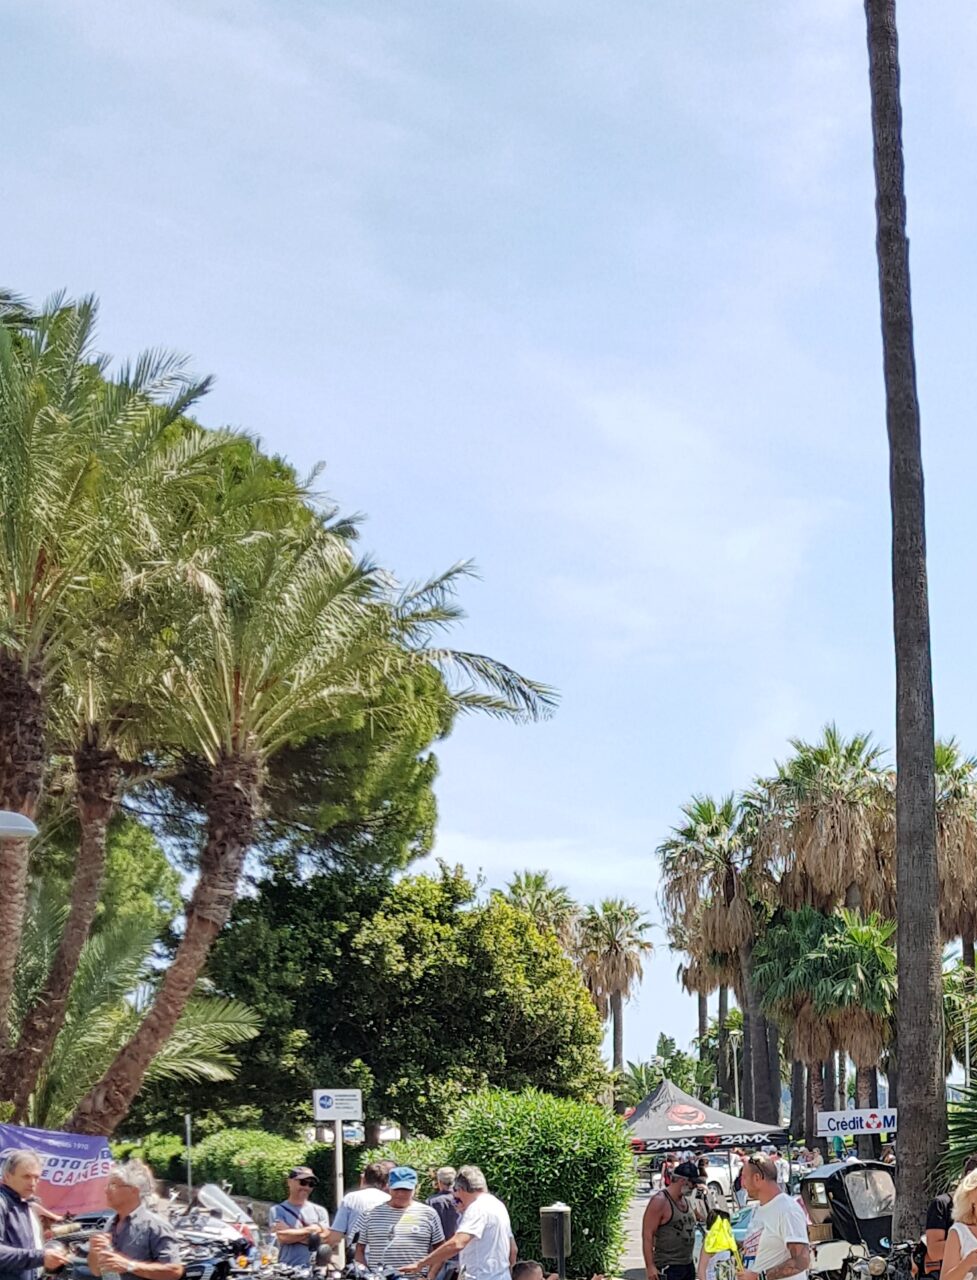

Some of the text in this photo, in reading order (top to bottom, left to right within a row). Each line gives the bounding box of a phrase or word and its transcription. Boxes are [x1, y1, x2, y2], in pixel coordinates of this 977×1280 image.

[827, 1115, 896, 1132] Crédit M
[646, 1133, 772, 1150] 24MX 24MX
[47, 1157, 81, 1170] OTO
